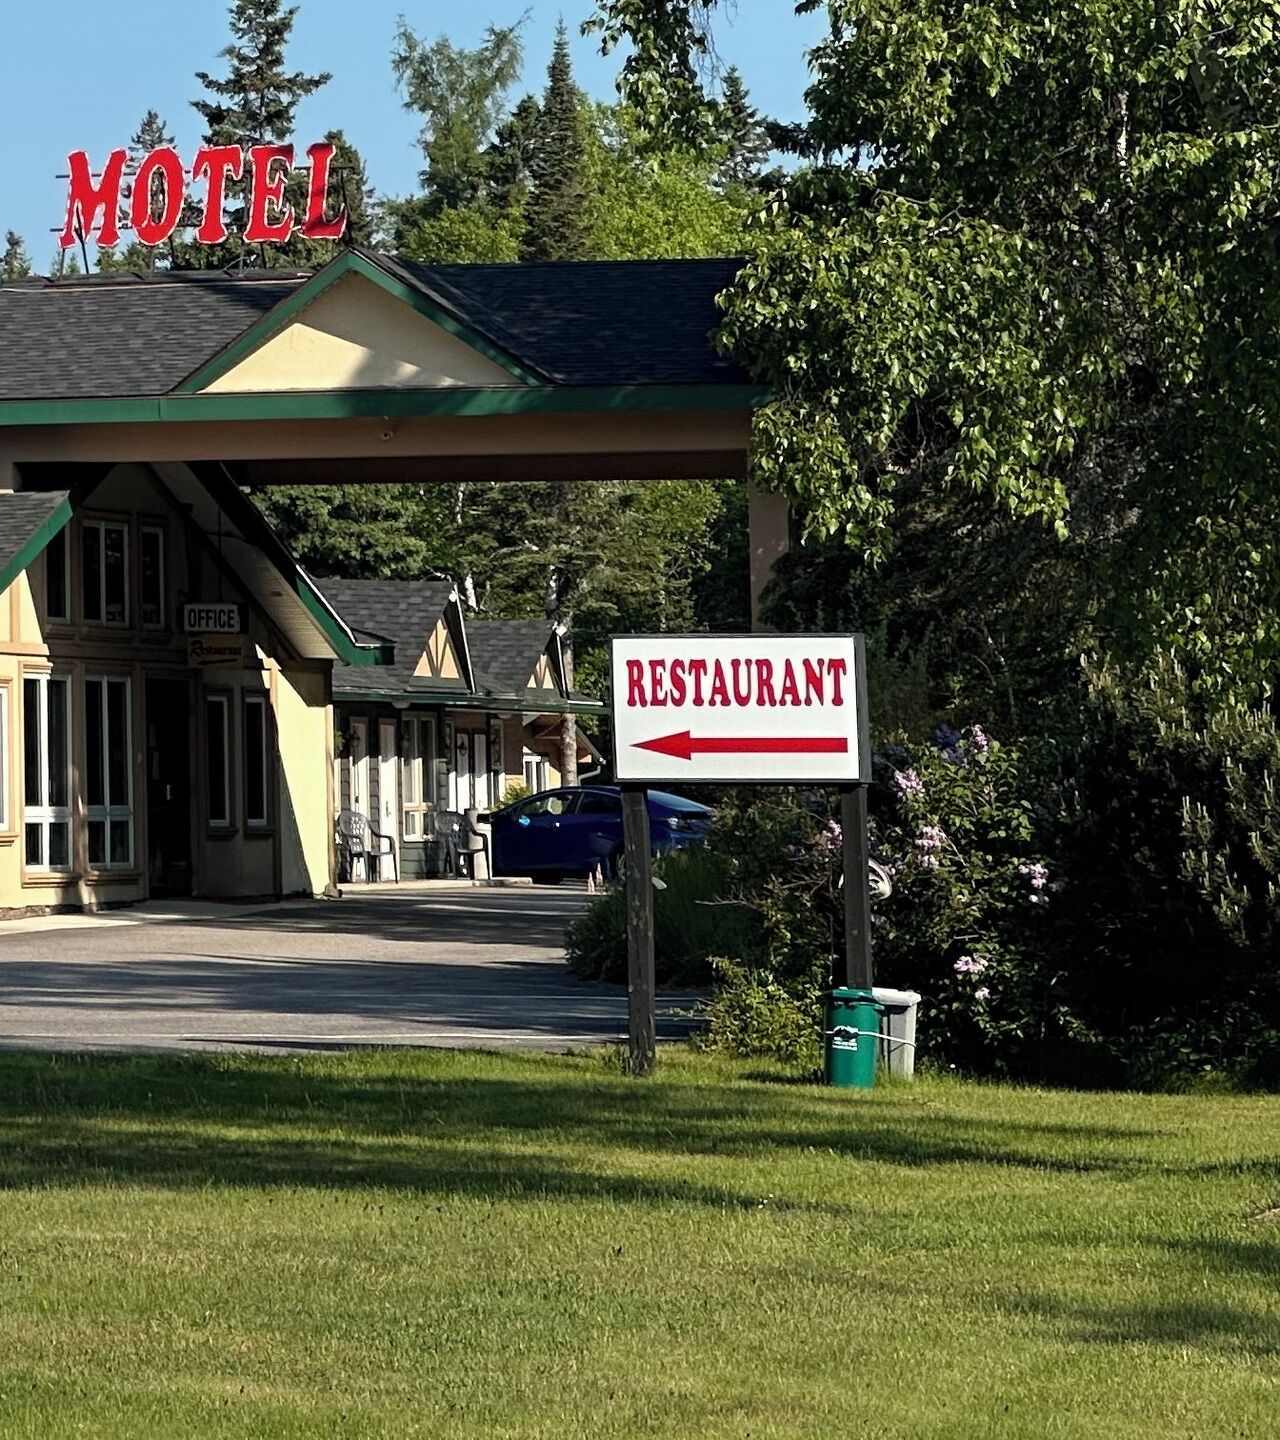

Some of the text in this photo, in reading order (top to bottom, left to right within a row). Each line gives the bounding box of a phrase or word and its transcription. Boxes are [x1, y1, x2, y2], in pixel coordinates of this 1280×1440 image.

[58, 142, 347, 249] MOTEL
[188, 608, 235, 628] OFFICE
[626, 658, 847, 707] RESTAURANT
